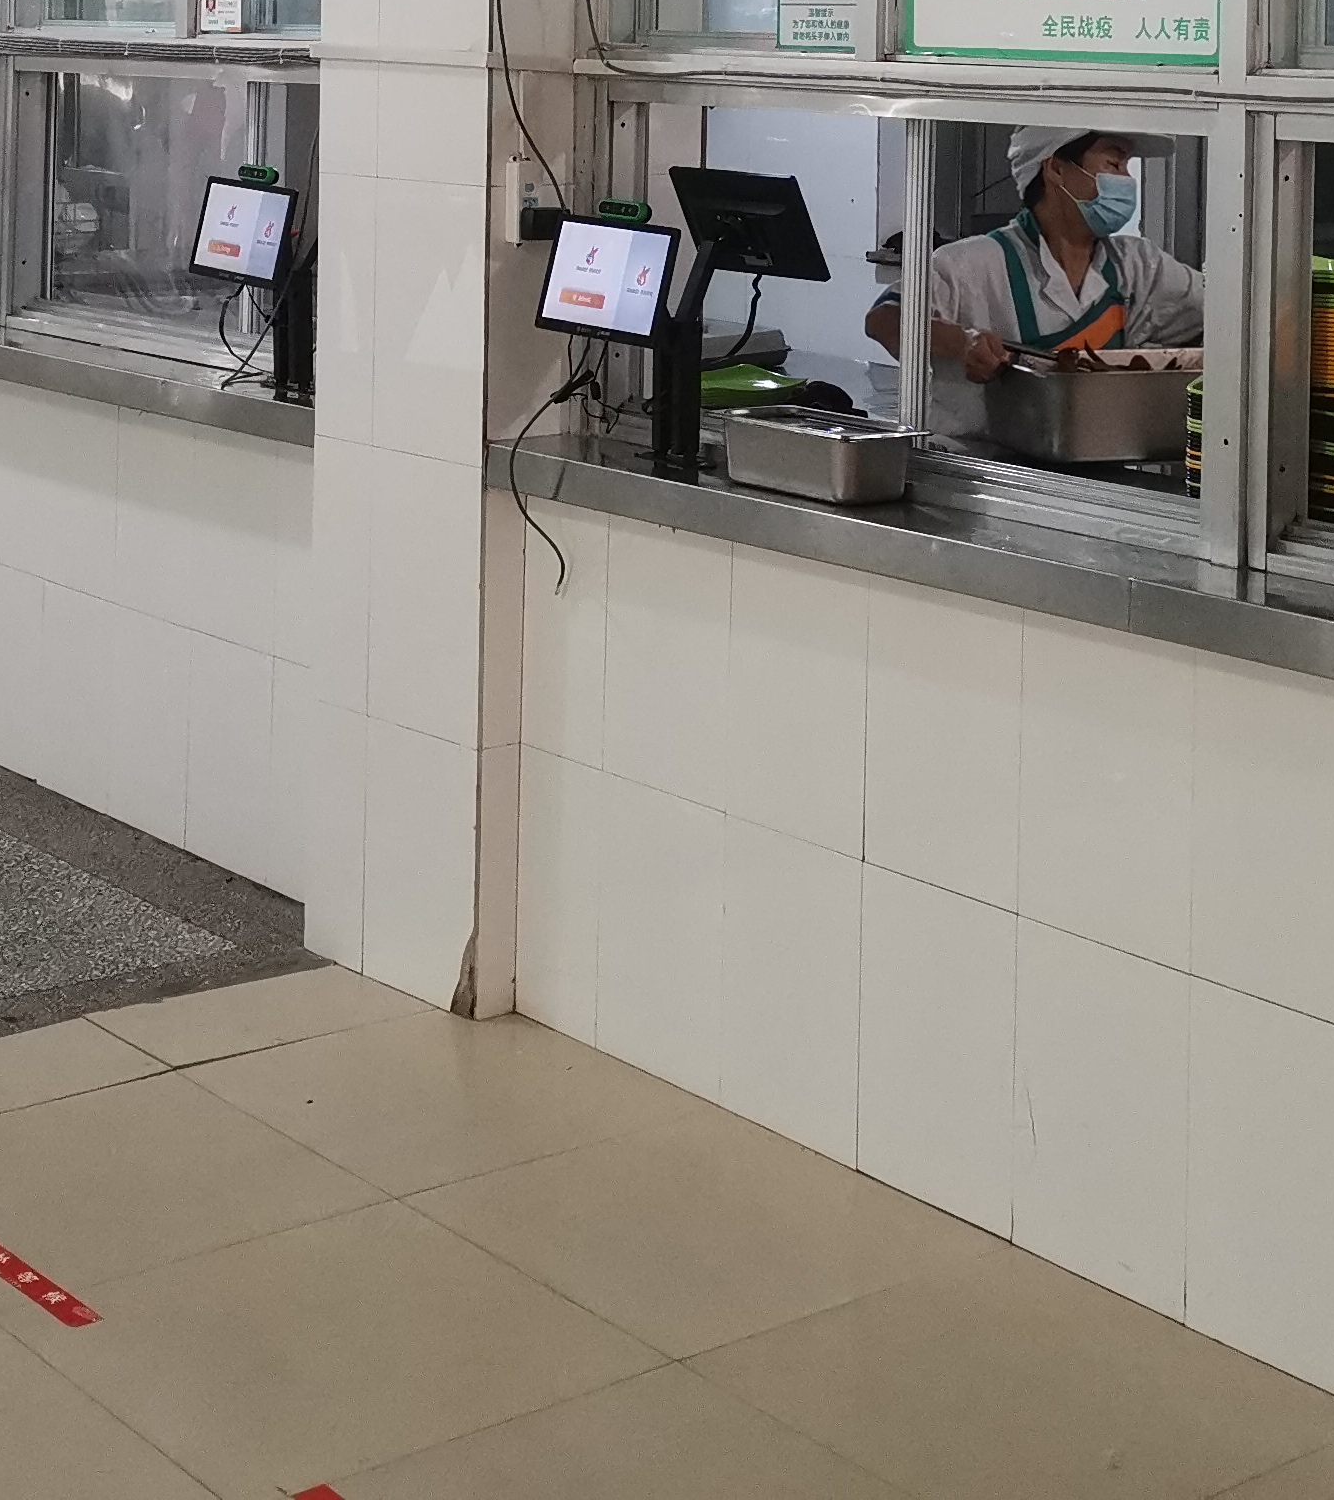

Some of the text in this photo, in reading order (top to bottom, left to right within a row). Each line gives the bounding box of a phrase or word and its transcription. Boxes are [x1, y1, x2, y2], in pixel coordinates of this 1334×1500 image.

[1042, 15, 1211, 43] 全民战疫 人人有责
